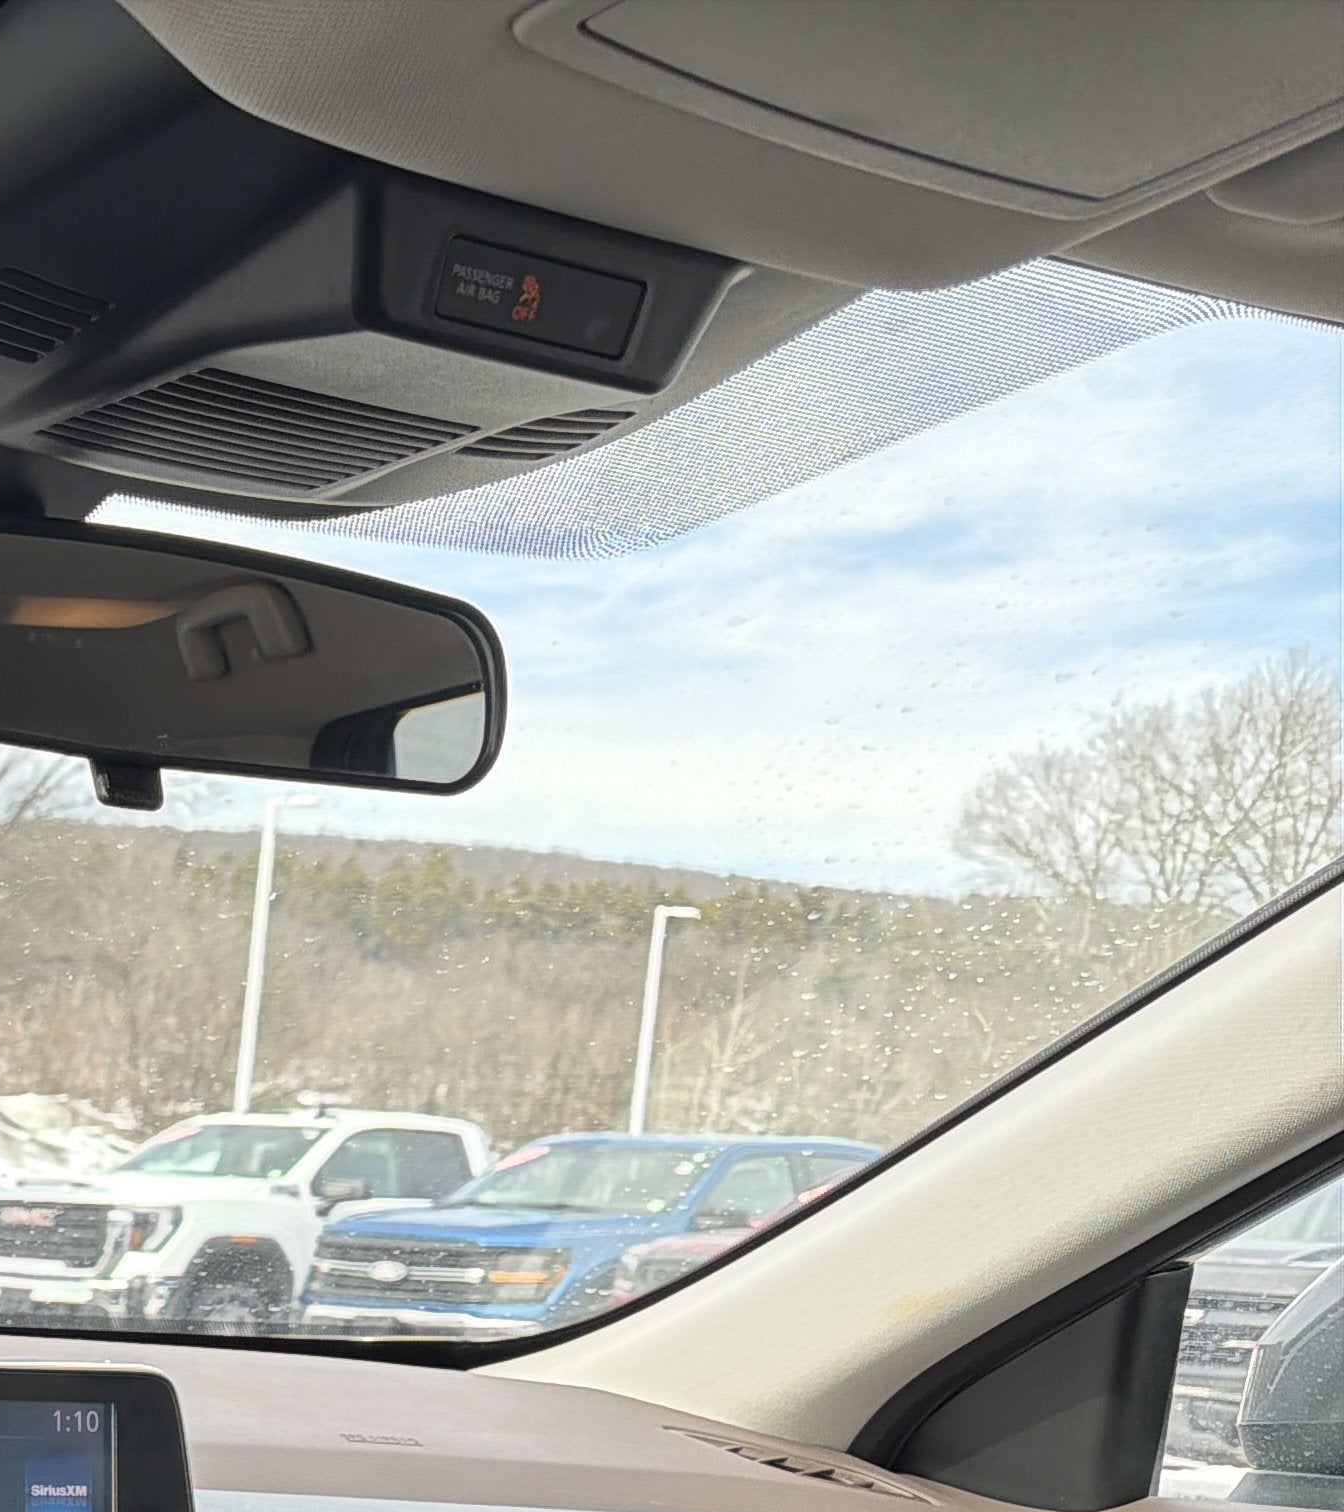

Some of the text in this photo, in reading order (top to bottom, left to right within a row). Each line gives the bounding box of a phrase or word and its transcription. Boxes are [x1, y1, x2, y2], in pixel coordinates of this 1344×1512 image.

[453, 264, 514, 290] PASSENGER
[456, 283, 501, 304] AIR BAG
[52, 1410, 99, 1432] 1:10
